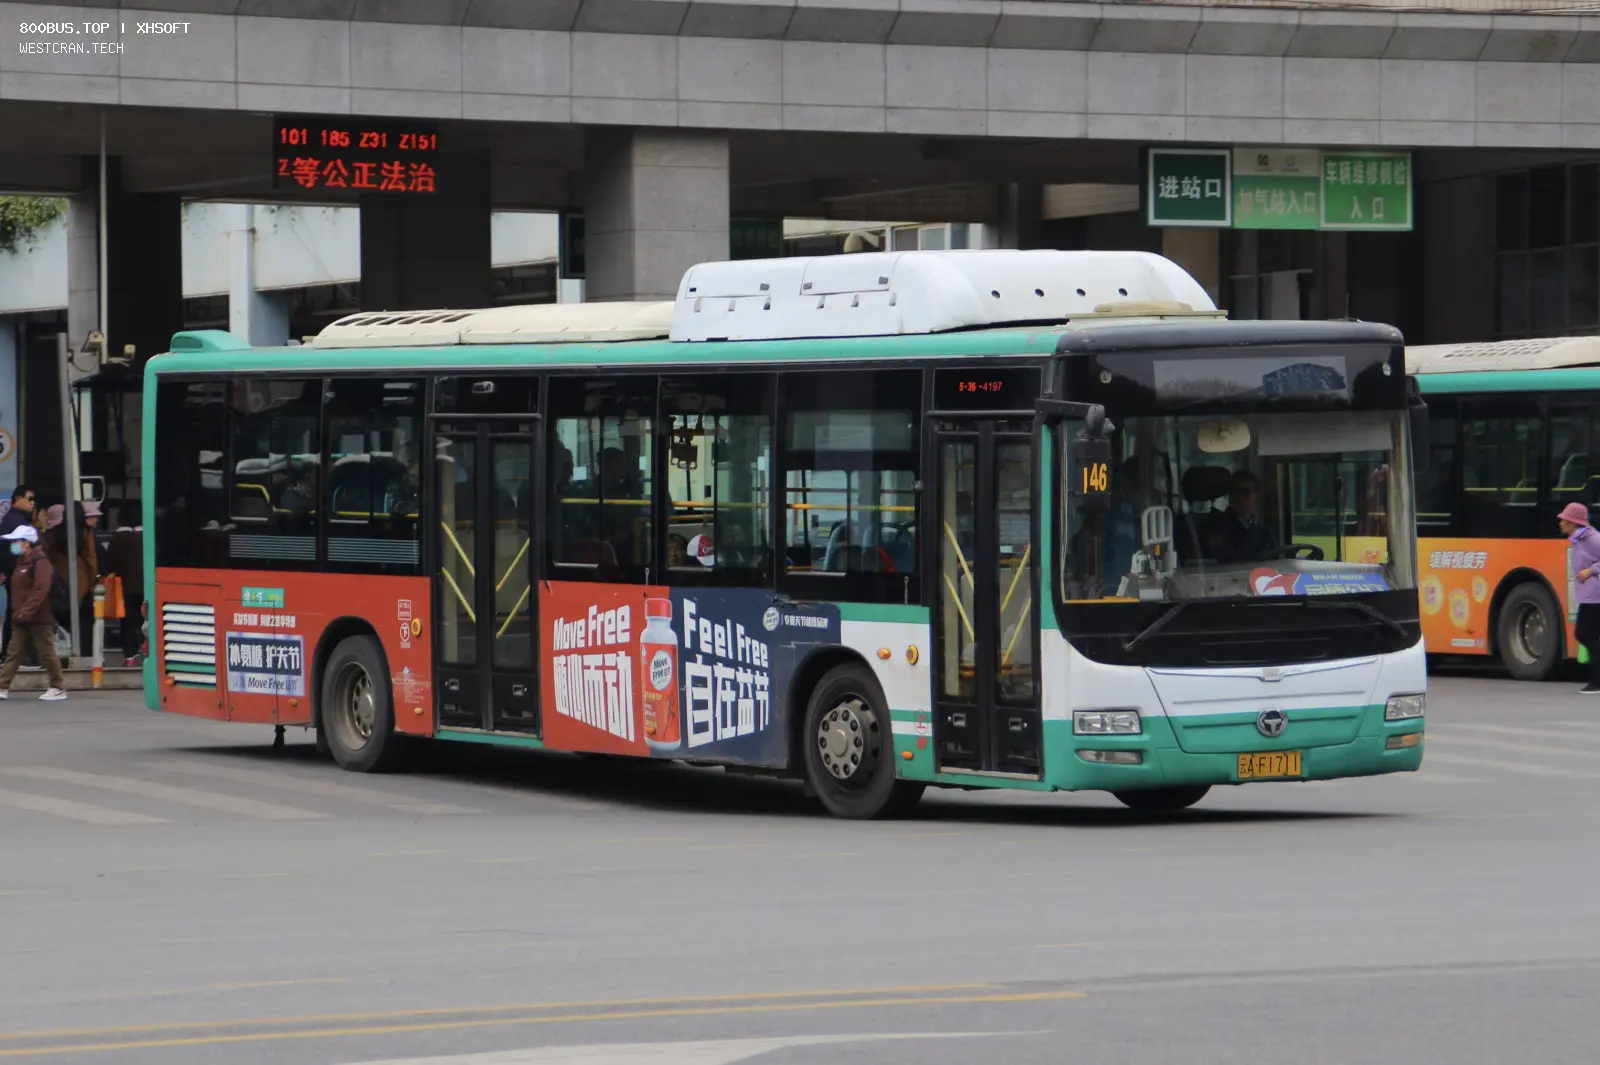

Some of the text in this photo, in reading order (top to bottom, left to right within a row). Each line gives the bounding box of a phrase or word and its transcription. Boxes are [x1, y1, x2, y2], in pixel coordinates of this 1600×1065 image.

[280, 128, 436, 149] 101 185 Z31 Z151
[1159, 176, 1222, 199] 进站口
[1350, 196, 1384, 220] 入口
[1083, 462, 1107, 494] 146
[553, 604, 631, 651] Move Free
[683, 597, 769, 668] Feel Free
[265, 644, 300, 670] 护关节
[653, 658, 668, 670] Move
[247, 676, 285, 691] Move Free
[652, 669, 664, 681] Free
[685, 653, 770, 749] 自在益节
